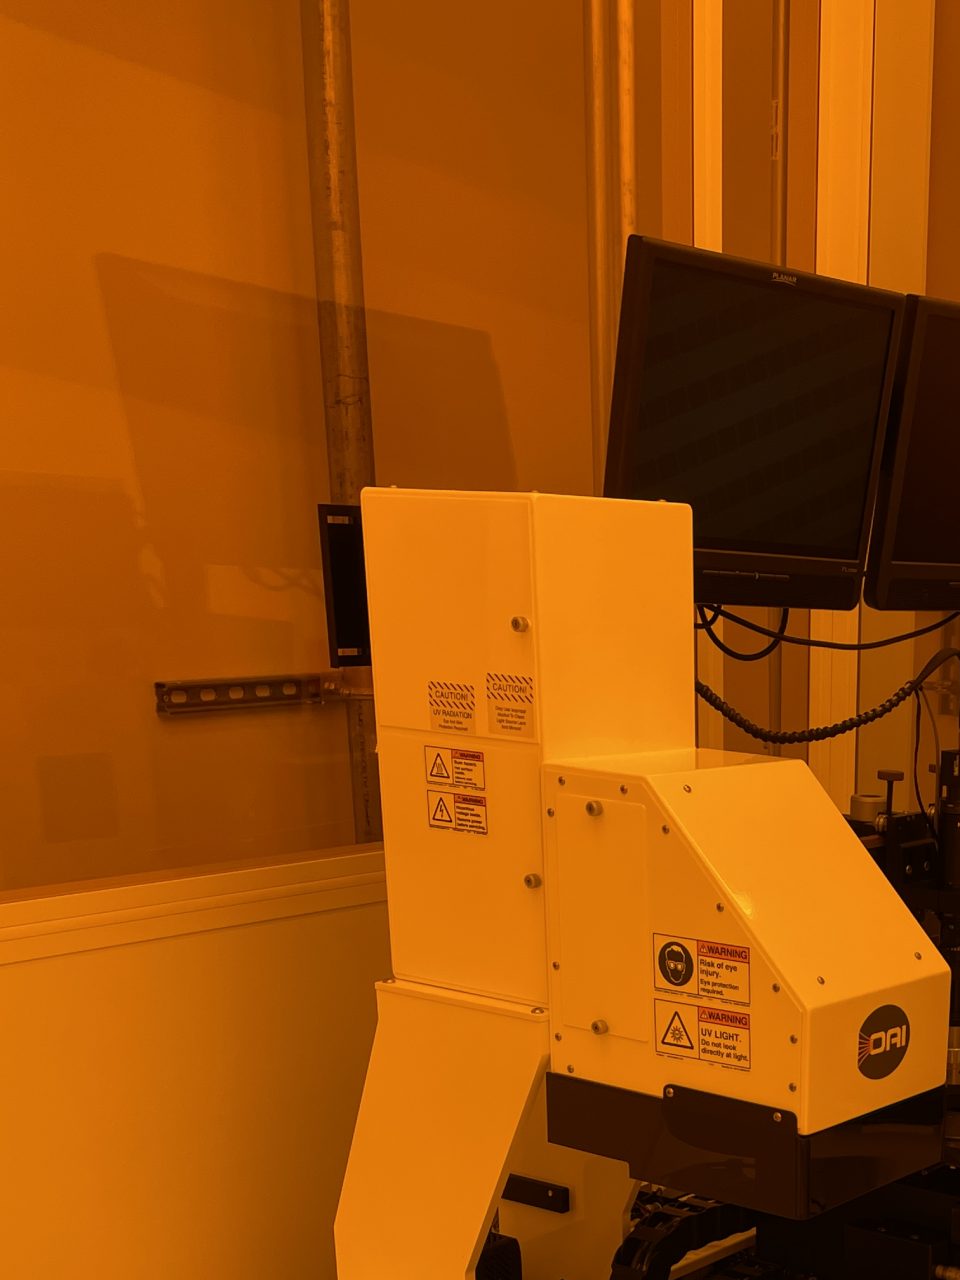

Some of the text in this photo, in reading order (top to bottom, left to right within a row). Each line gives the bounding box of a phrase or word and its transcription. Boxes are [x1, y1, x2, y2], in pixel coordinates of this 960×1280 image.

[772, 272, 797, 283] PLANAR
[492, 682, 527, 694] CAUTION!
[435, 690, 468, 701] CAUTION!
[433, 708, 472, 719] UV RADIATION
[707, 944, 748, 960] WARNING
[700, 959, 738, 973] Risk of eye
[700, 968, 721, 979] injury.
[700, 978, 740, 991] Eye protection
[700, 987, 724, 996] required.
[707, 1011, 748, 1026] WARNING
[700, 1027, 742, 1043] UV LIGHT.
[869, 1024, 907, 1056] OAI
[701, 1038, 737, 1051] Do not look
[701, 1047, 724, 1058] directly
[733, 1051, 748, 1062] light.
